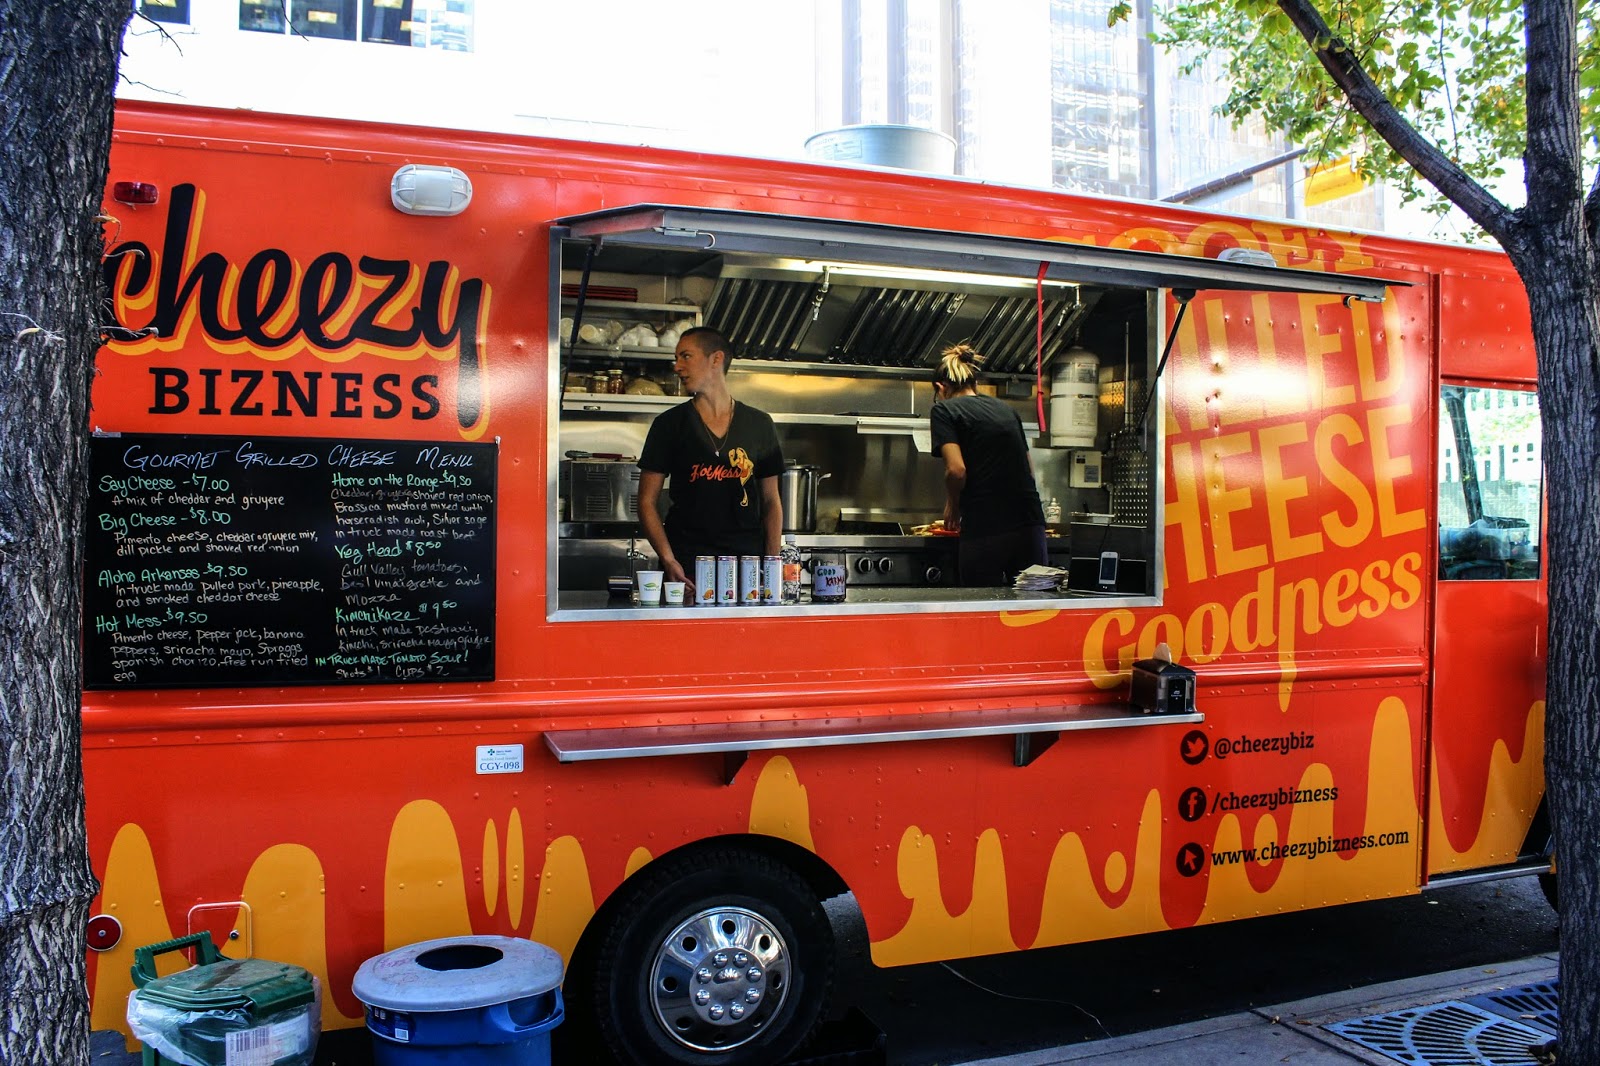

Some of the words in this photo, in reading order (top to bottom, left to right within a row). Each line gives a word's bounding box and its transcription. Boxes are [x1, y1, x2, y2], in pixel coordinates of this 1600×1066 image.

[148, 366, 442, 421] BIZNESS
[123, 445, 231, 471] GOURMET
[328, 444, 396, 468] CHEESE
[127, 476, 176, 491] Cheese
[331, 472, 365, 487] Home
[368, 476, 382, 486] on
[384, 473, 402, 486] the
[126, 495, 147, 506] mix
[150, 493, 164, 505] of
[168, 493, 211, 505] cheddar
[215, 493, 236, 505] and
[242, 495, 285, 510] gruyere
[413, 490, 445, 500] shaved
[449, 493, 464, 501] red
[387, 501, 427, 511] mustard
[431, 502, 458, 511] mixed
[461, 503, 483, 512] with
[99, 514, 128, 535] Big
[130, 514, 177, 526] Cheese
[335, 514, 399, 526] horseradish
[464, 516, 487, 529] sage
[114, 532, 161, 545] Pimento
[347, 526, 382, 537] truck
[387, 527, 415, 537] made
[420, 528, 448, 538] roast
[117, 544, 135, 556] dill
[140, 545, 171, 556] pickle
[179, 543, 200, 553] and
[205, 543, 242, 553] shaved
[247, 543, 265, 553] red
[334, 543, 363, 565] Veg
[367, 539, 403, 557] Head
[99, 569, 136, 588] Aloha
[141, 568, 200, 582] Arkansas
[455, 573, 482, 587] and
[164, 582, 196, 592] made
[201, 580, 235, 595] pulled
[116, 597, 141, 608] and
[145, 594, 189, 604] smoked
[196, 592, 244, 604] cheddar
[245, 591, 282, 602] cheese
[96, 615, 120, 634] Hot
[125, 613, 162, 629] Mess
[382, 623, 413, 635] made
[112, 630, 153, 644] Pimento
[196, 629, 232, 645] pepper
[263, 627, 304, 639] banana
[1082, 551, 1423, 712] Goodness
[163, 644, 216, 656] sriracha
[251, 658, 273, 666] run
[276, 653, 309, 666] fried
[315, 657, 326, 666] IN
[113, 671, 137, 682] egg
[1214, 731, 1315, 759] @cheezybiz
[480, 761, 520, 771] CGY-098
[1211, 786, 1339, 814] /cheezybizness
[1211, 831, 1409, 866] www.cheezybizness.com
